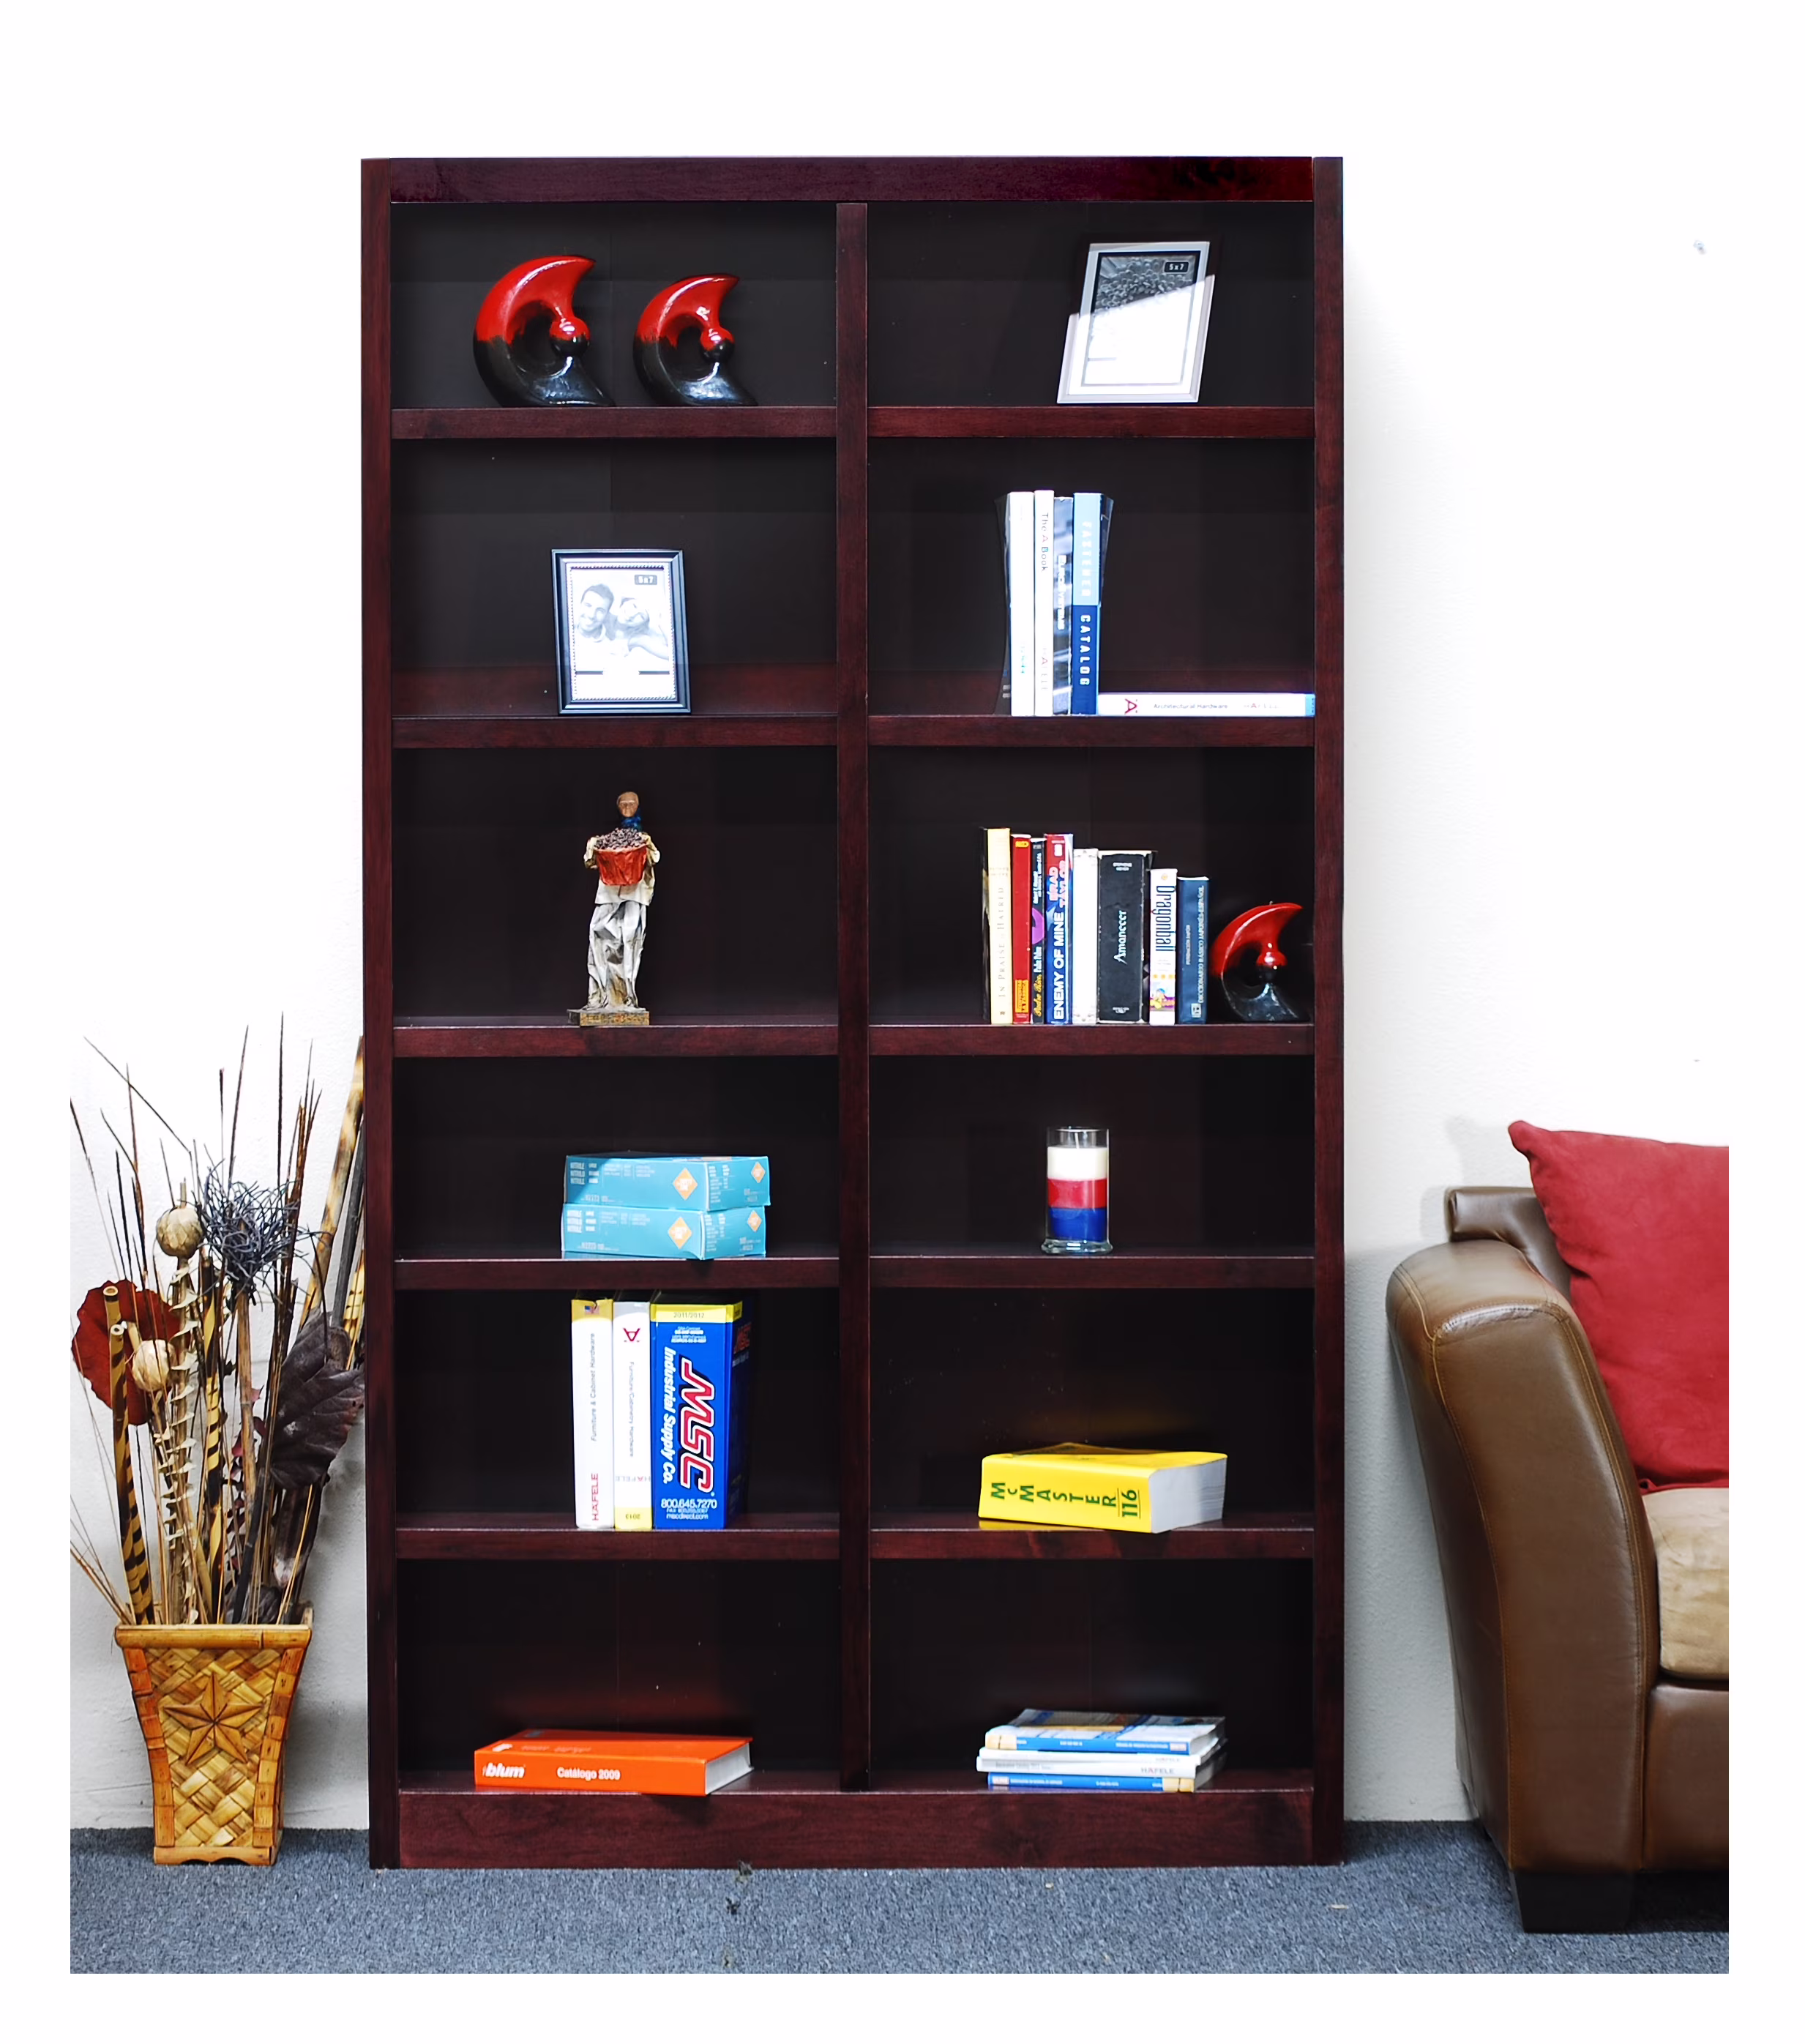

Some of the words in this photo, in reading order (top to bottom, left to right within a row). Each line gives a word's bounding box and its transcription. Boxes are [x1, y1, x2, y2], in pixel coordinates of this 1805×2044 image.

[1041, 546, 1049, 572] Book
[1081, 521, 1092, 597] FASTENER
[1080, 614, 1091, 686] CATALOG
[1048, 866, 1058, 901] BRAD
[1058, 860, 1066, 909] TAYLOR
[1053, 911, 1064, 947] MINE
[1113, 910, 1128, 965] Amanecer
[1152, 885, 1176, 952] Dragonball
[1053, 948, 1064, 969] OF
[1053, 971, 1064, 1020] ENEMY
[664, 1346, 676, 1413] Industrial
[660, 1413, 676, 1461] Supply
[680, 1357, 714, 1493] MSC
[662, 1461, 676, 1484] Co.
[1121, 1489, 1138, 1518] 116
[485, 1763, 525, 1779] blum
[556, 1767, 597, 1782] Catálogo
[598, 1769, 621, 1780] 2009
